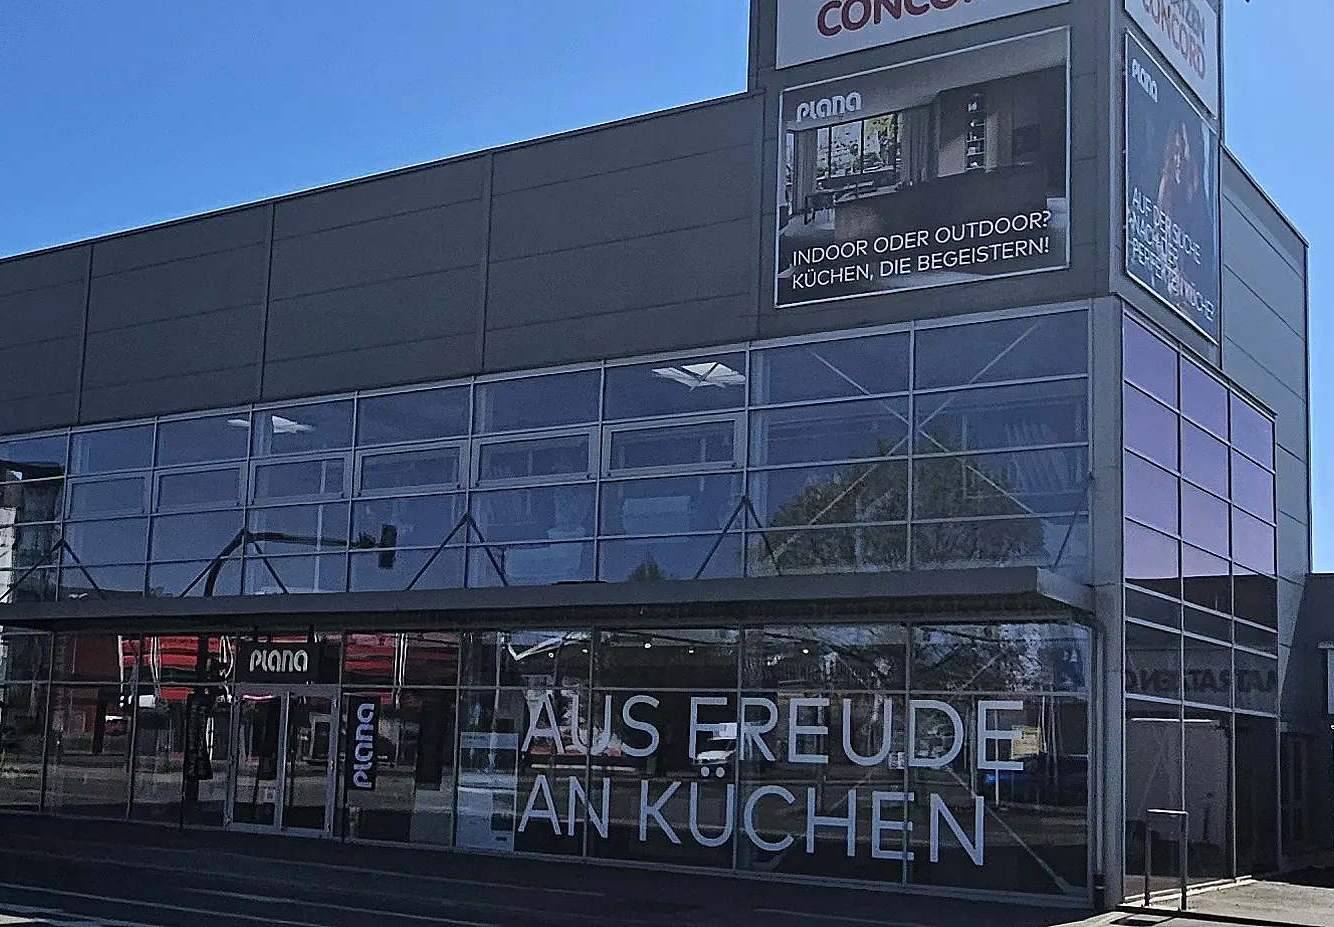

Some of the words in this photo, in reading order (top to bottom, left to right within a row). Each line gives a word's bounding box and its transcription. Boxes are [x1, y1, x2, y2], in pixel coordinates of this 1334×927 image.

[792, 240, 868, 267] INDOOR
[873, 230, 929, 254] ODER
[934, 210, 1052, 244] OUTDOOR?
[792, 263, 874, 290] KÜCHEN,
[879, 257, 912, 278] DIE
[917, 236, 1051, 272] BEGEISTERN!
[249, 649, 309, 673] plana
[521, 693, 660, 757] AUS
[689, 696, 1024, 771] FREUDE
[518, 773, 610, 839] AN
